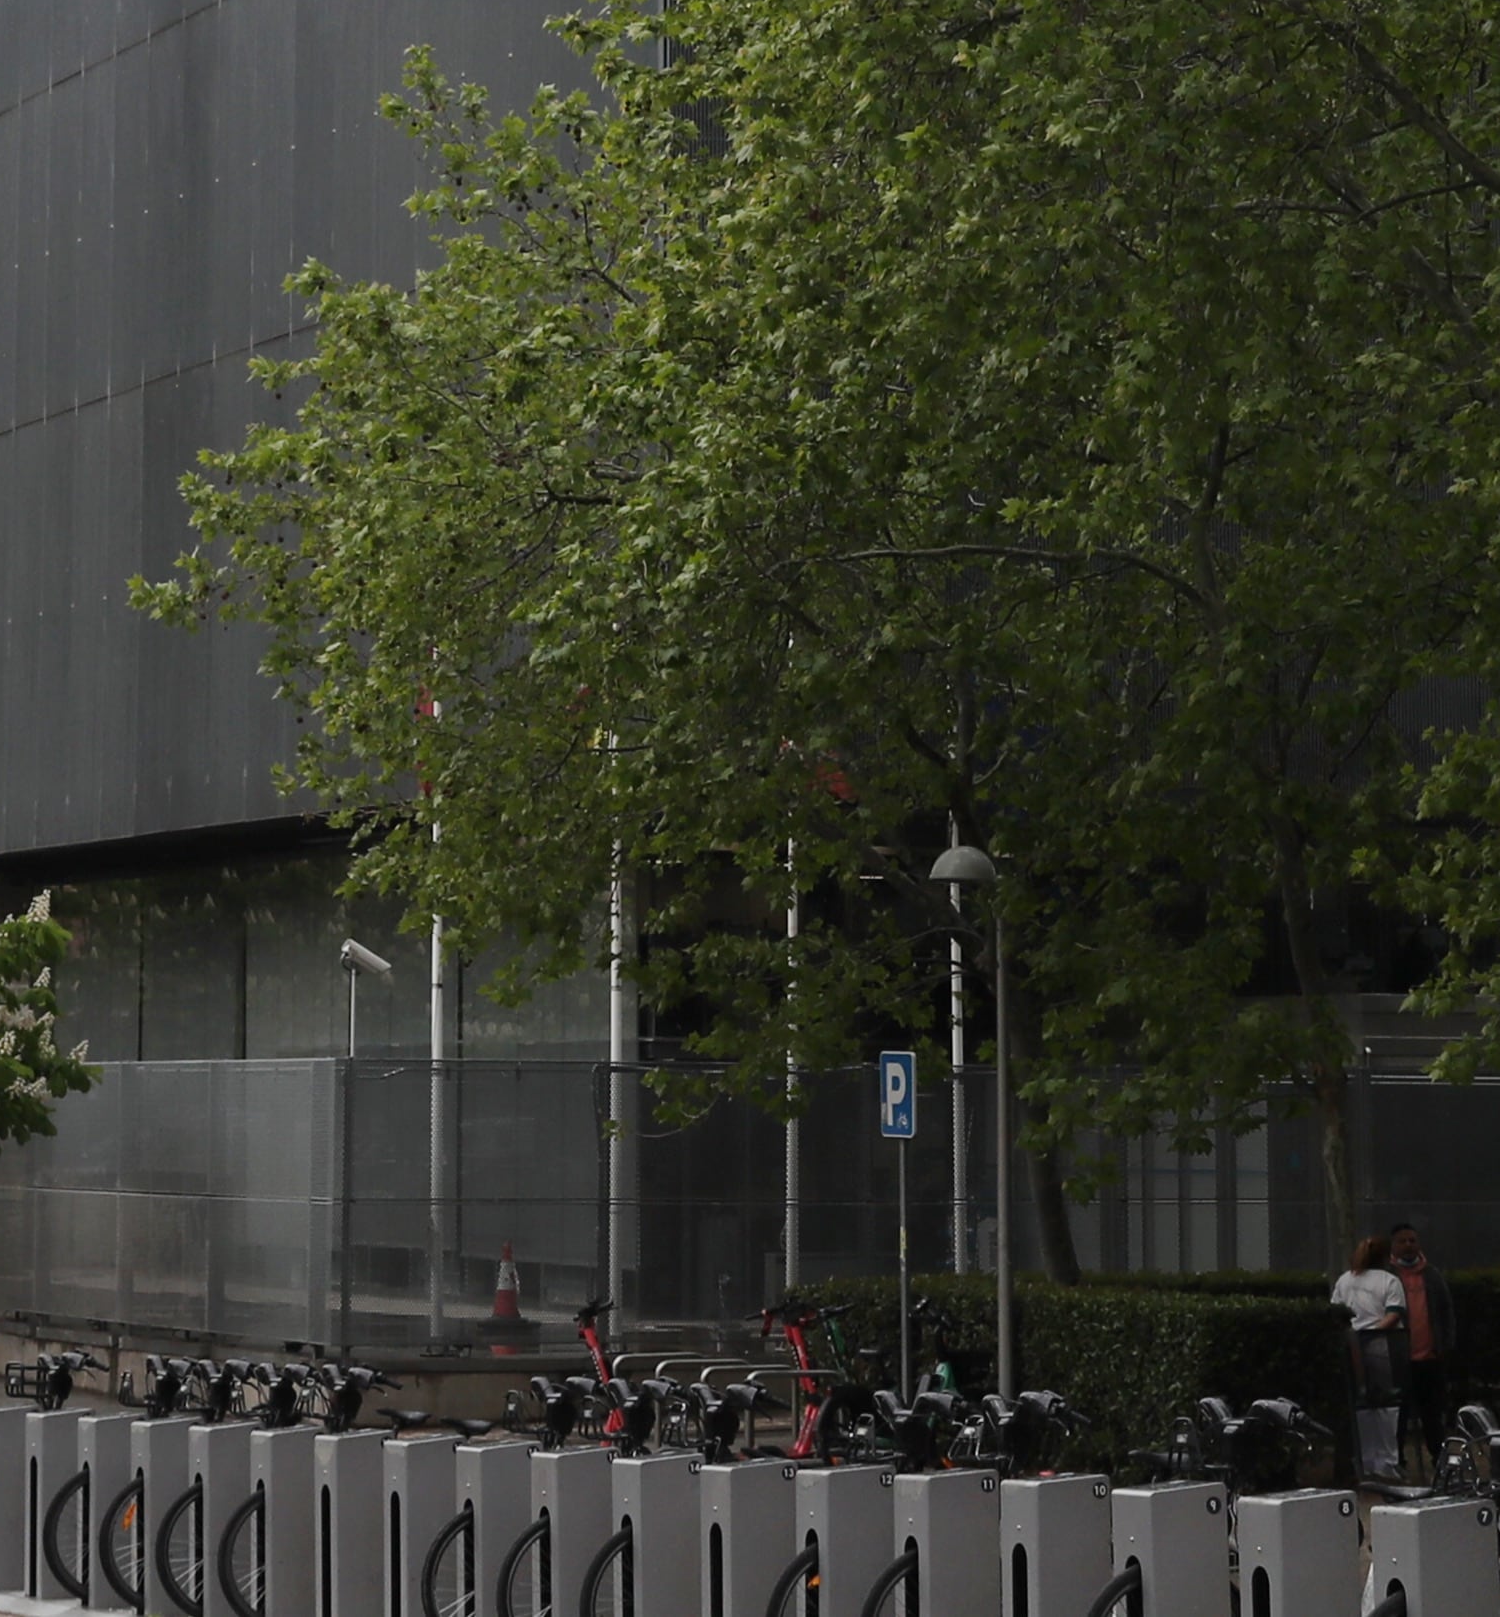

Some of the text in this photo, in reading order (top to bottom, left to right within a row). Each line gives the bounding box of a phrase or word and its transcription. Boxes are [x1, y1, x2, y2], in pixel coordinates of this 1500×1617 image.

[886, 1062, 906, 1126] P
[690, 1462, 701, 1473] 14
[784, 1467, 795, 1478] 13
[882, 1473, 893, 1484] 12
[983, 1478, 995, 1489] 11
[1094, 1484, 1106, 1497] 10
[1209, 1499, 1218, 1511] 9
[1342, 1501, 1350, 1514] 8
[1481, 1510, 1489, 1523] 7
